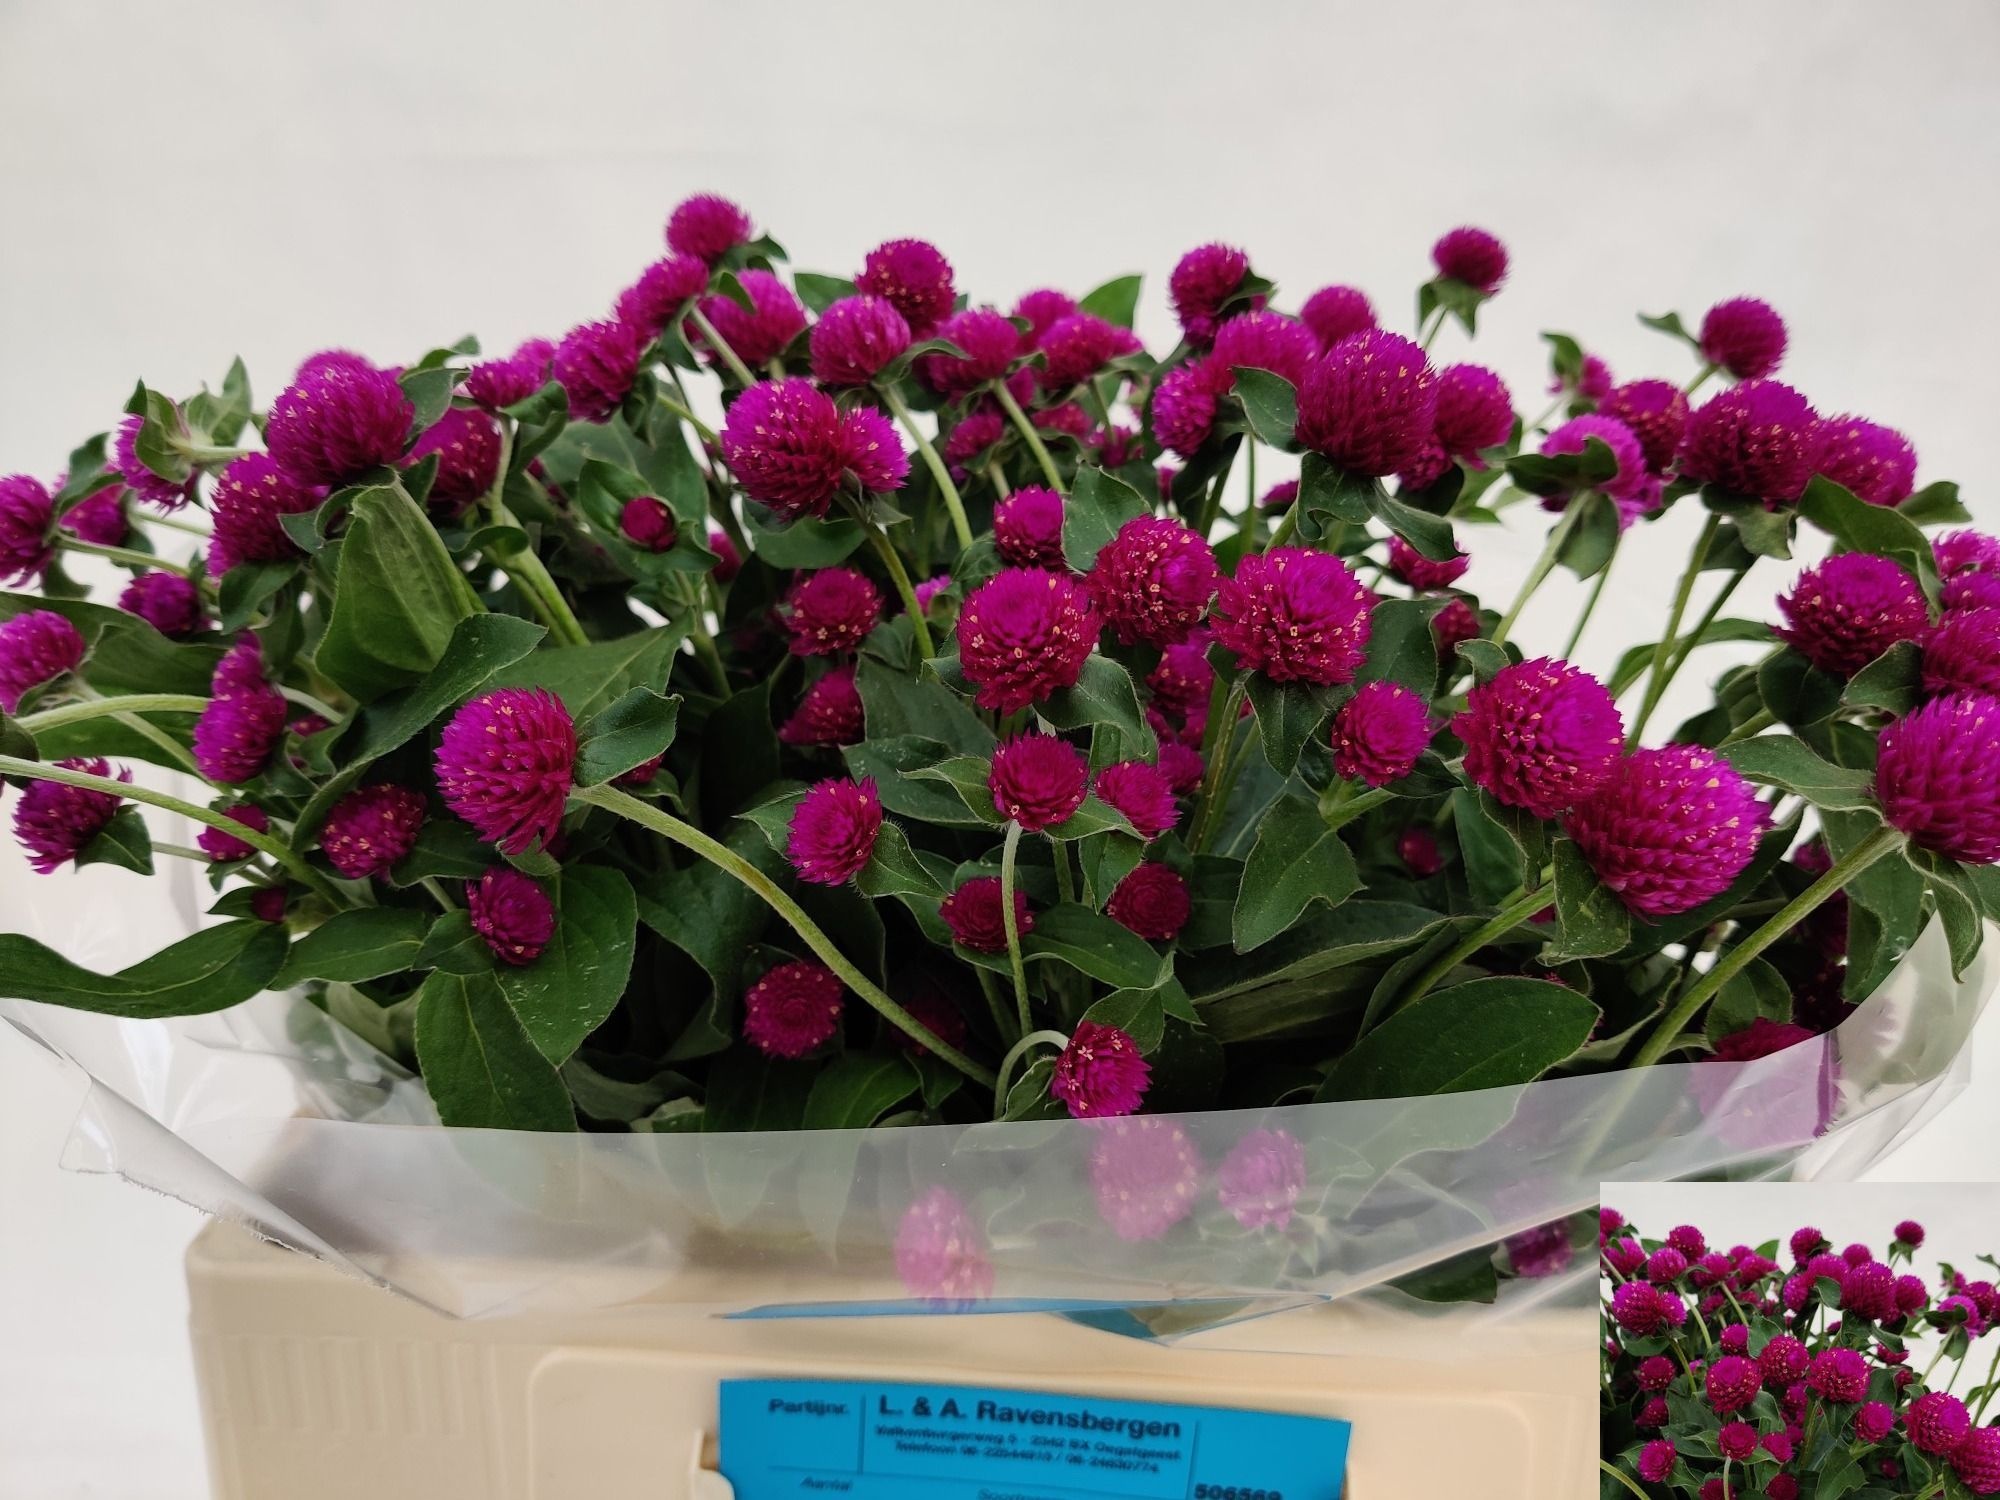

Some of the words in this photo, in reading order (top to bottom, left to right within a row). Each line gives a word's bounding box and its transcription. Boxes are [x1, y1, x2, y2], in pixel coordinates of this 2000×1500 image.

[878, 1395, 903, 1415] L.
[912, 1397, 932, 1416] &
[940, 1398, 967, 1419] A.
[976, 1400, 1181, 1439] Ravensbergen
